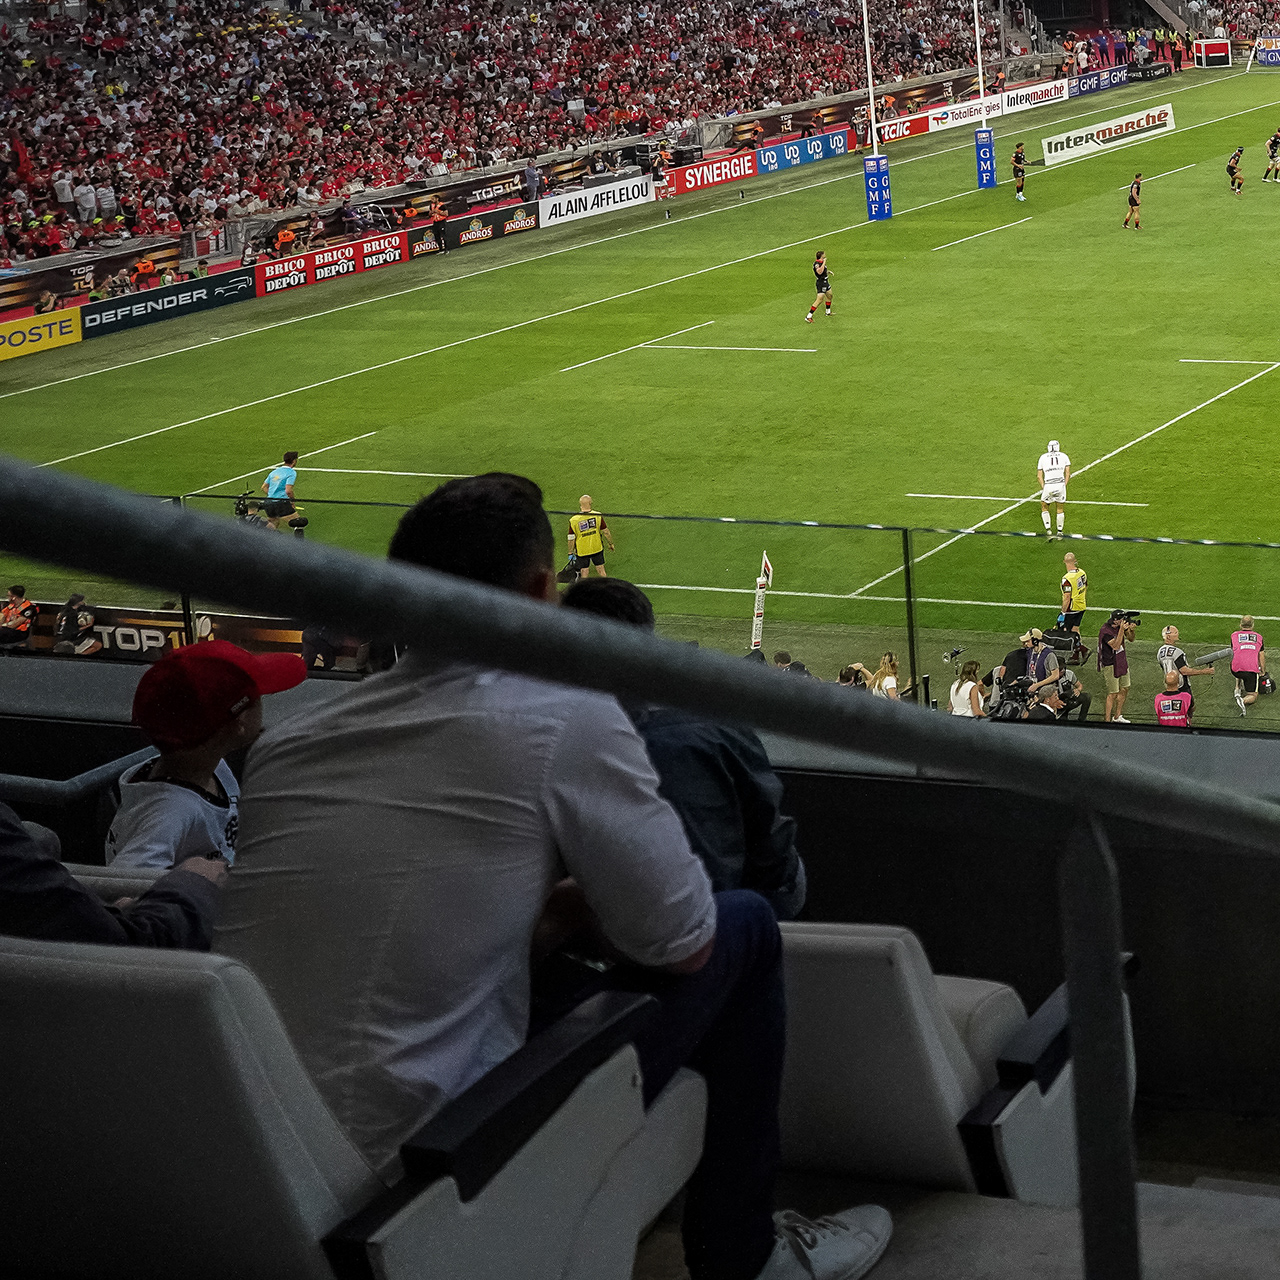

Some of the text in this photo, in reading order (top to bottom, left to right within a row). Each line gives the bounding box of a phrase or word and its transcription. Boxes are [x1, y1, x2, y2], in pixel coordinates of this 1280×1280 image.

[1080, 77, 1098, 91] GMF
[1110, 71, 1128, 84] GMF
[1007, 83, 1064, 108] Intermarché
[950, 102, 1000, 122] TotalEnegies
[1047, 110, 1169, 154] Intermarché
[685, 155, 753, 189] SYNERGIE
[548, 199, 588, 221] ALAIN
[591, 181, 649, 212] AFFLELOU
[505, 217, 536, 232] ANDROS
[461, 227, 492, 243] ANDROS
[363, 236, 400, 255] BRICO
[414, 241, 439, 255] ANDR
[315, 246, 354, 267] BRICO
[364, 249, 401, 271] DEPÔT
[70, 265, 95, 276] TOP
[265, 258, 305, 278] BRICO
[316, 260, 356, 282] DEPÔT
[266, 271, 306, 292] DEPÔT
[85, 289, 208, 328] DEFENDER
[1051, 457, 1059, 466] 11
